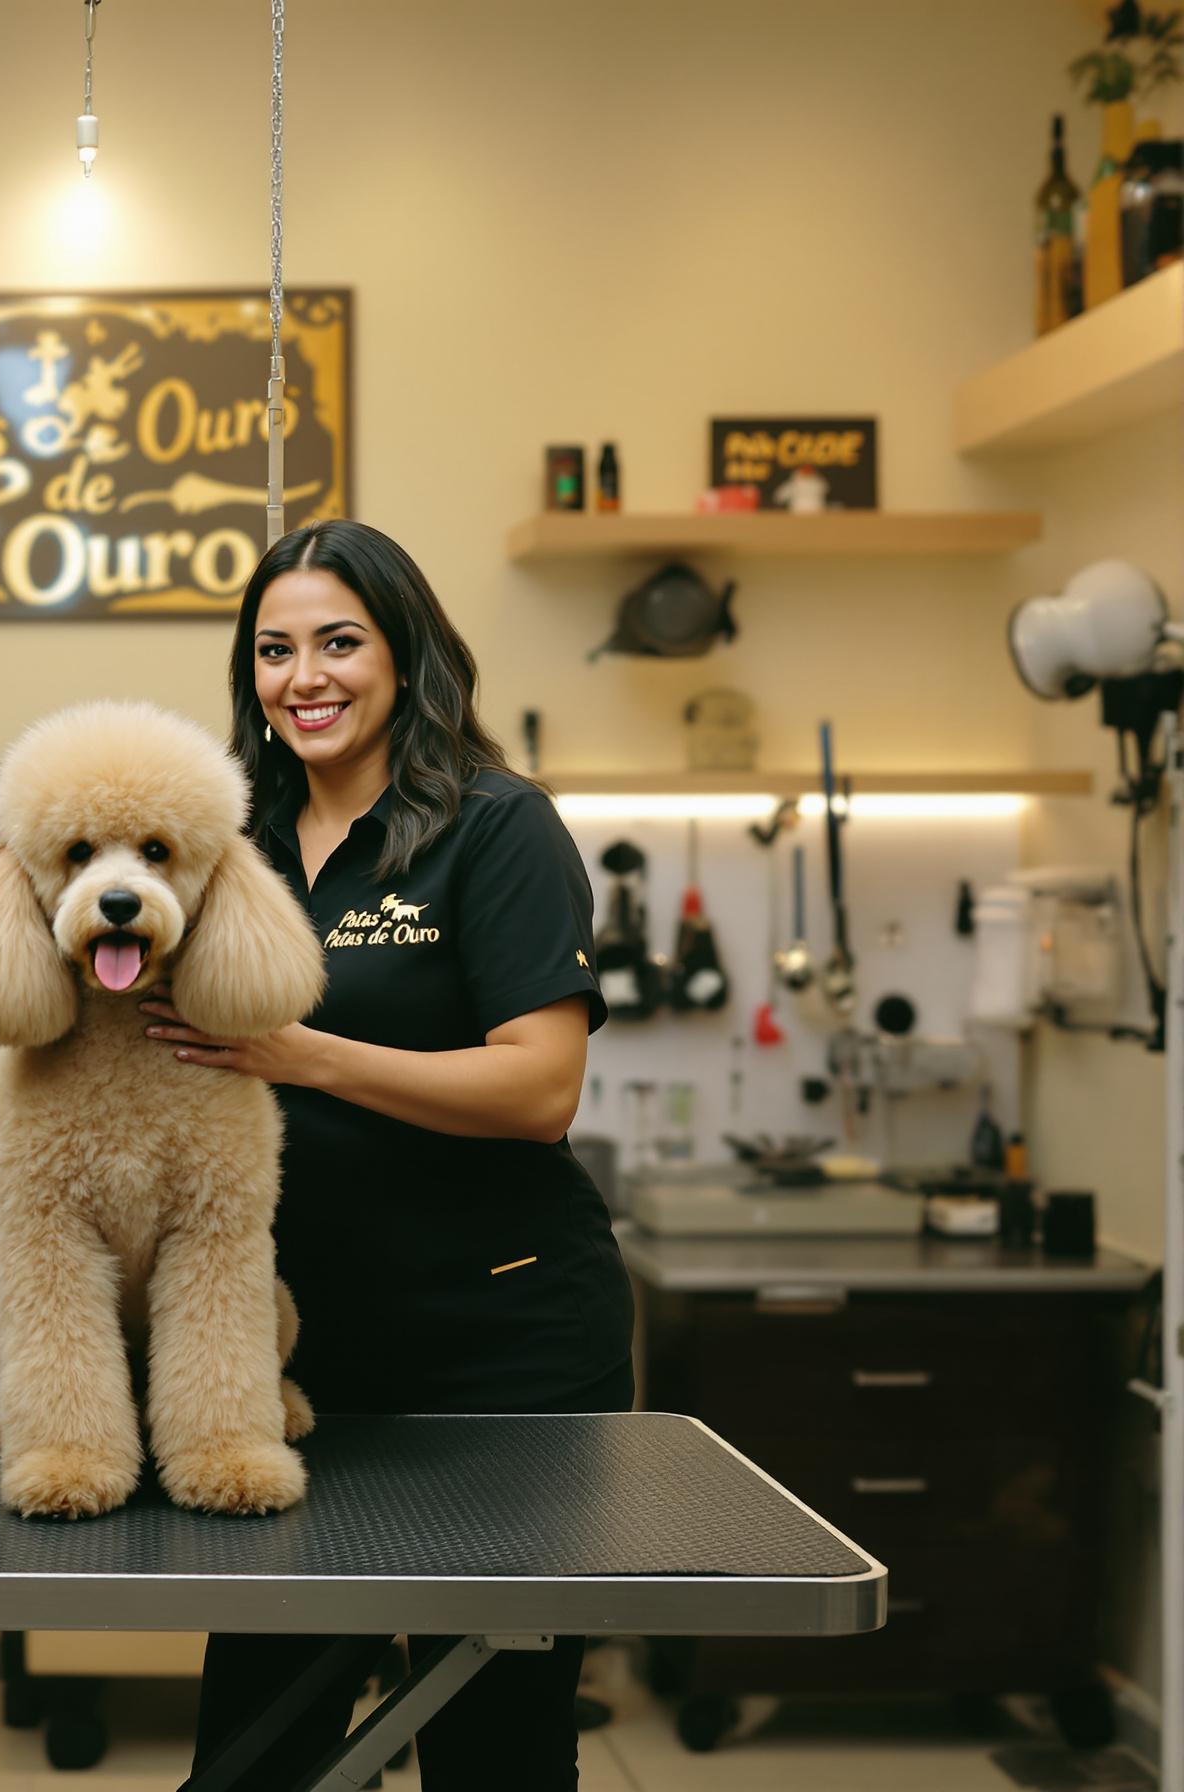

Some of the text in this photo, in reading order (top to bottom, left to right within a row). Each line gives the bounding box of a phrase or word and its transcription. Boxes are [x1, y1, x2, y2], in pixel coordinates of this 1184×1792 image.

[43, 454, 115, 514] de
[2, 513, 258, 607] Ouro
[367, 920, 393, 945] de
[393, 923, 440, 945] Ouro
